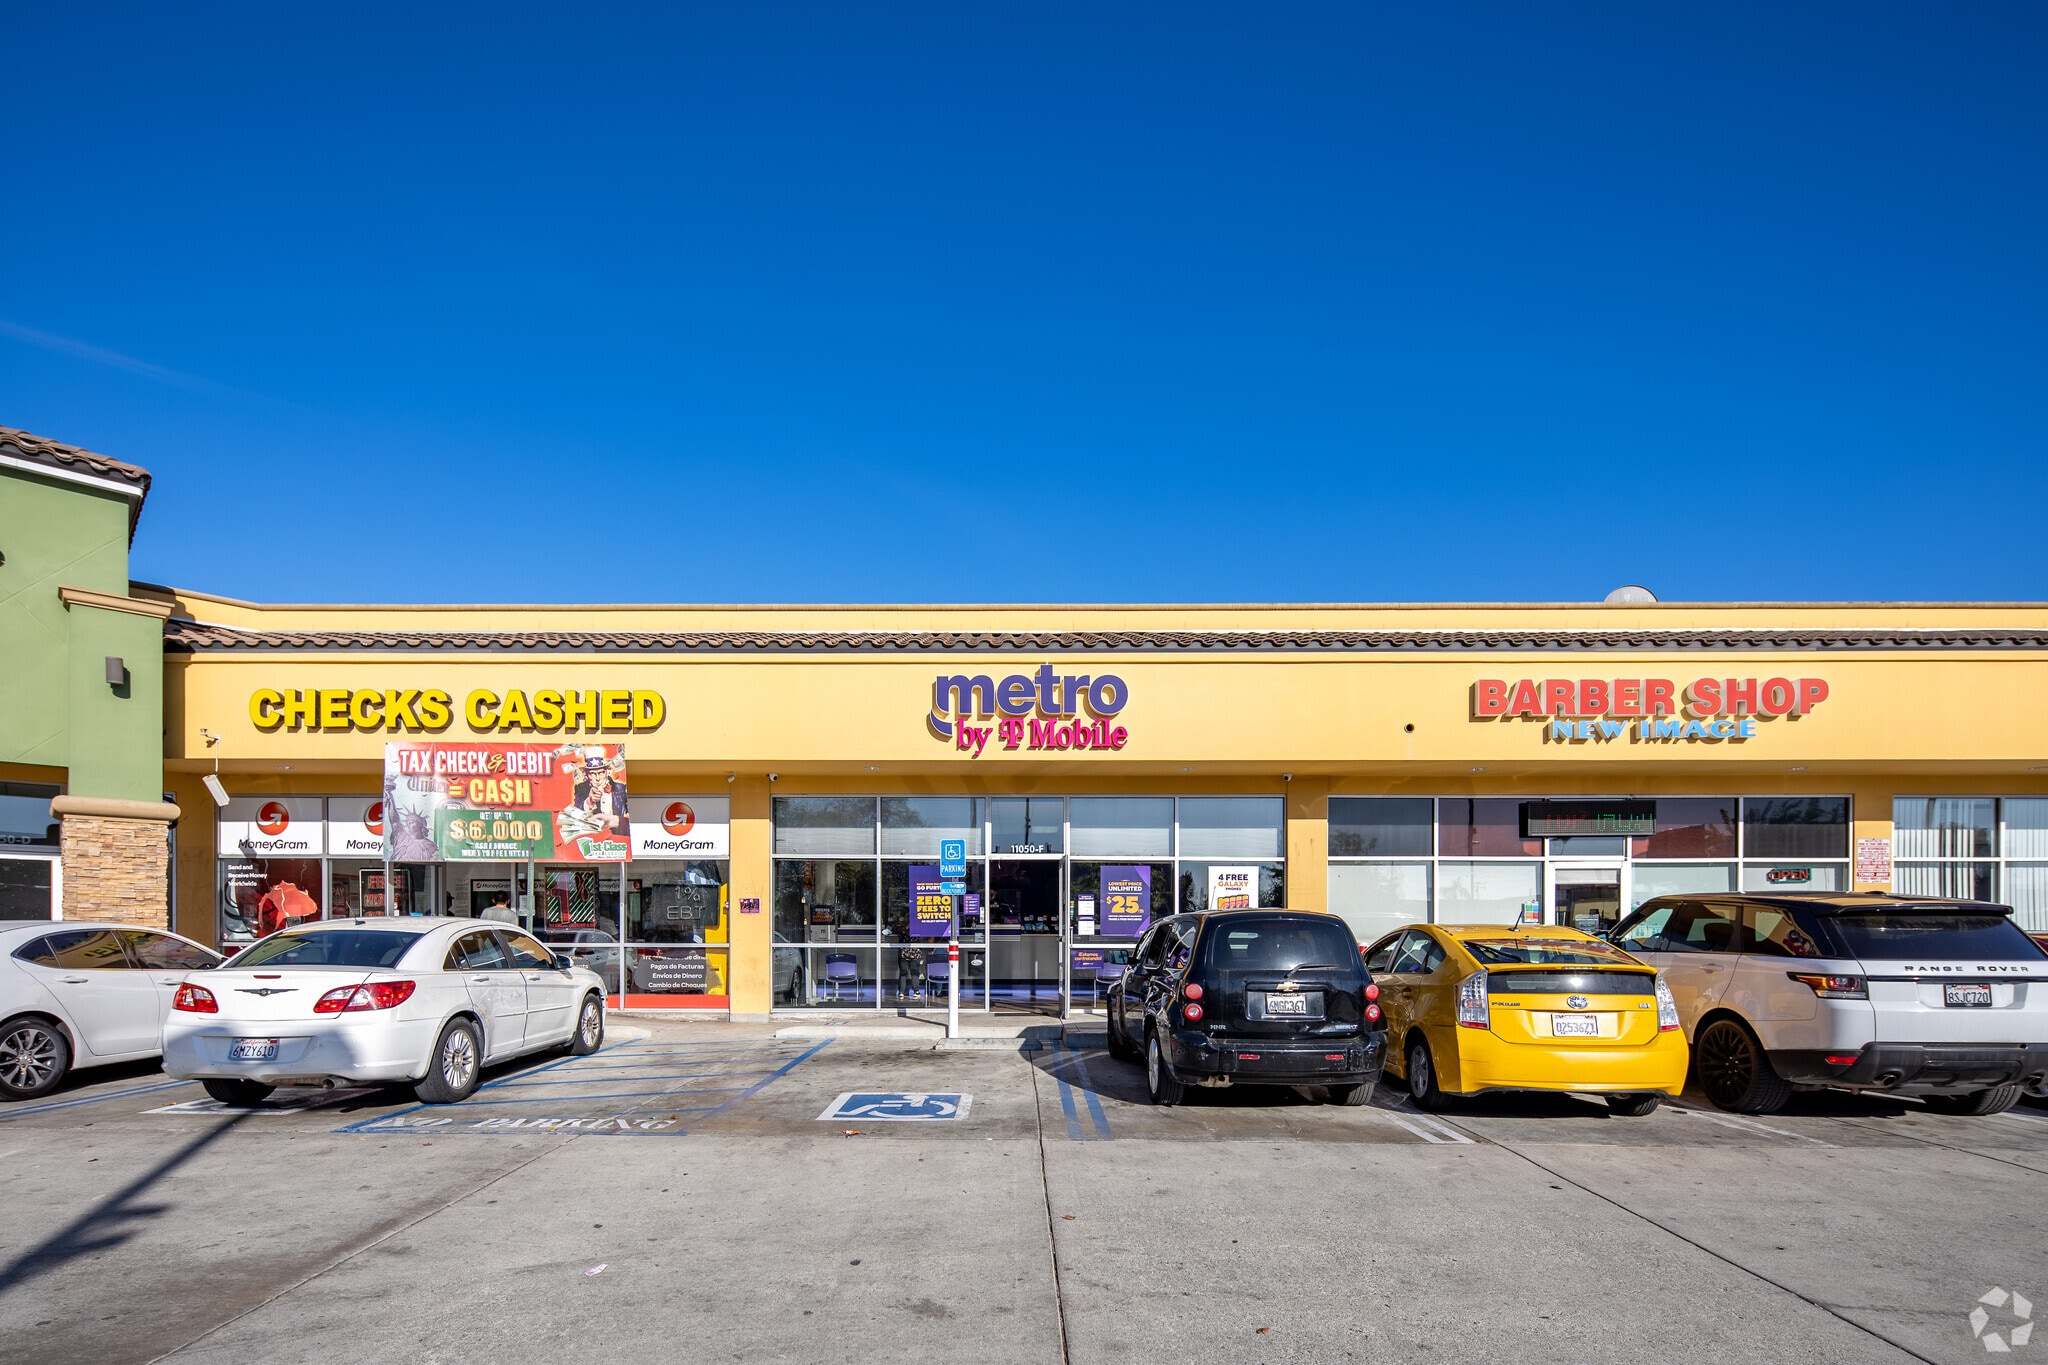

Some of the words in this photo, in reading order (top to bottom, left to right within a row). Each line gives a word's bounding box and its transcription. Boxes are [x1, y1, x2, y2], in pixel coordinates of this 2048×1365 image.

[932, 664, 1129, 718] metro
[1477, 677, 1675, 716] BARBER
[1691, 677, 1830, 716] SHOP
[249, 688, 451, 730] CHECKS
[465, 689, 664, 730] CASHED
[1552, 720, 1629, 739] NEW
[1640, 720, 1757, 739] IMAGE
[957, 718, 993, 756] by
[1001, 718, 1025, 747] T
[1031, 718, 1129, 748] Mobile
[400, 750, 432, 774] TAX
[435, 750, 489, 774] CHECK
[488, 753, 507, 773] &
[507, 752, 553, 774] DEBIT
[469, 777, 532, 805] CA$H
[450, 818, 544, 842] $6,000
[238, 839, 308, 851] MoneyGram
[346, 839, 383, 851] Money
[603, 841, 627, 852] Class
[643, 839, 714, 852] MoneyGram
[1011, 845, 1044, 854] 11050-F
[941, 865, 965, 873] PARKING
[1769, 869, 1809, 880] OPEN
[916, 895, 951, 905] ZERO
[1106, 895, 1139, 914] $25
[667, 905, 706, 920] EBT
[916, 912, 951, 920] SWITCH
[650, 963, 669, 971] Pagos
[680, 981, 708, 989] Cheques
[1948, 992, 1989, 1003] 8SJC720
[232, 1045, 275, 1057] 6MZY610
[470, 1117, 677, 1130] PARKING
